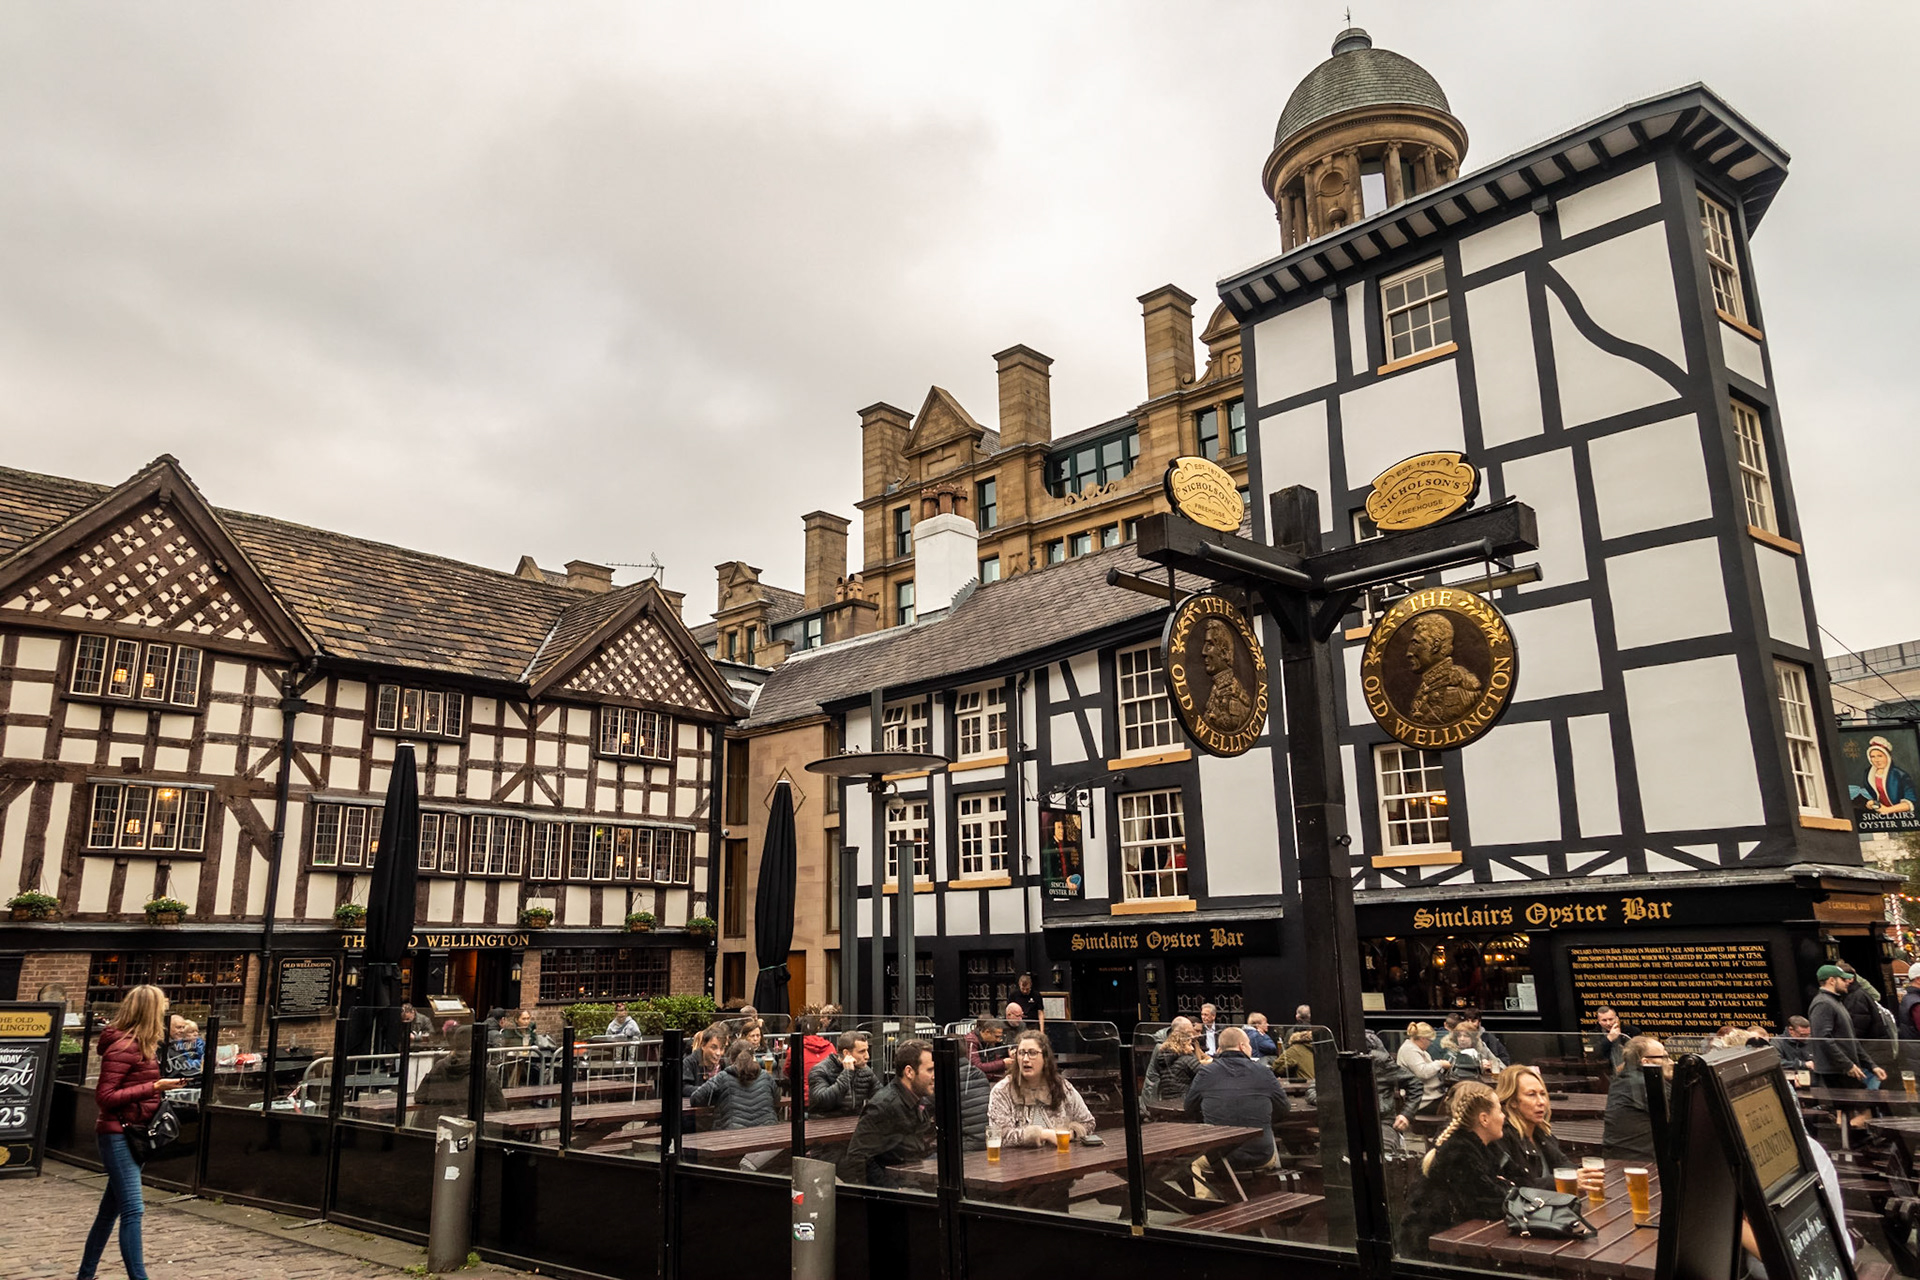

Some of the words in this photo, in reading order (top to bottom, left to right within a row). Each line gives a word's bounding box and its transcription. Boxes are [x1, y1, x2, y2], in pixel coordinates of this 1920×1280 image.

[1207, 467, 1220, 478] 1873
[1396, 464, 1414, 477] EST.
[1416, 460, 1436, 468] 1873
[1182, 482, 1236, 512] NICHOLSON'S
[1380, 478, 1460, 511] NICHOLSON'S
[1194, 503, 1225, 518] FREEHOUSE
[1397, 498, 1443, 516] FREEHOUSE
[1200, 597, 1234, 619] THE
[1405, 590, 1453, 613] THE
[1171, 663, 1194, 710] OLD
[1194, 681, 1268, 753] WELLINGTON
[1364, 675, 1389, 717] OLD
[1394, 656, 1511, 746] WELLINGTON
[1859, 821, 1897, 829] OYSTER
[1902, 820, 1920, 828] BAR
[1862, 811, 1915, 820] SINCLAIR'S
[1413, 904, 1513, 929] Sinclairs
[1525, 902, 1608, 928] Oyster
[1621, 896, 1673, 924] Bar
[341, 935, 367, 948] TH
[426, 934, 530, 947] WELLINGTON
[1071, 932, 1139, 951] Sinclairs
[1146, 930, 1201, 952] Oyster
[1209, 927, 1245, 950] Bar
[1708, 999, 1718, 1007] 20
[1733, 1012, 1767, 1020] ARNDALE
[0, 1024, 47, 1032] LINGTON
[0, 1055, 22, 1063] NDAY
[0, 1062, 34, 1086] ast
[0, 1106, 26, 1127] 25
[1750, 1127, 1793, 1168] ELLINGTON
